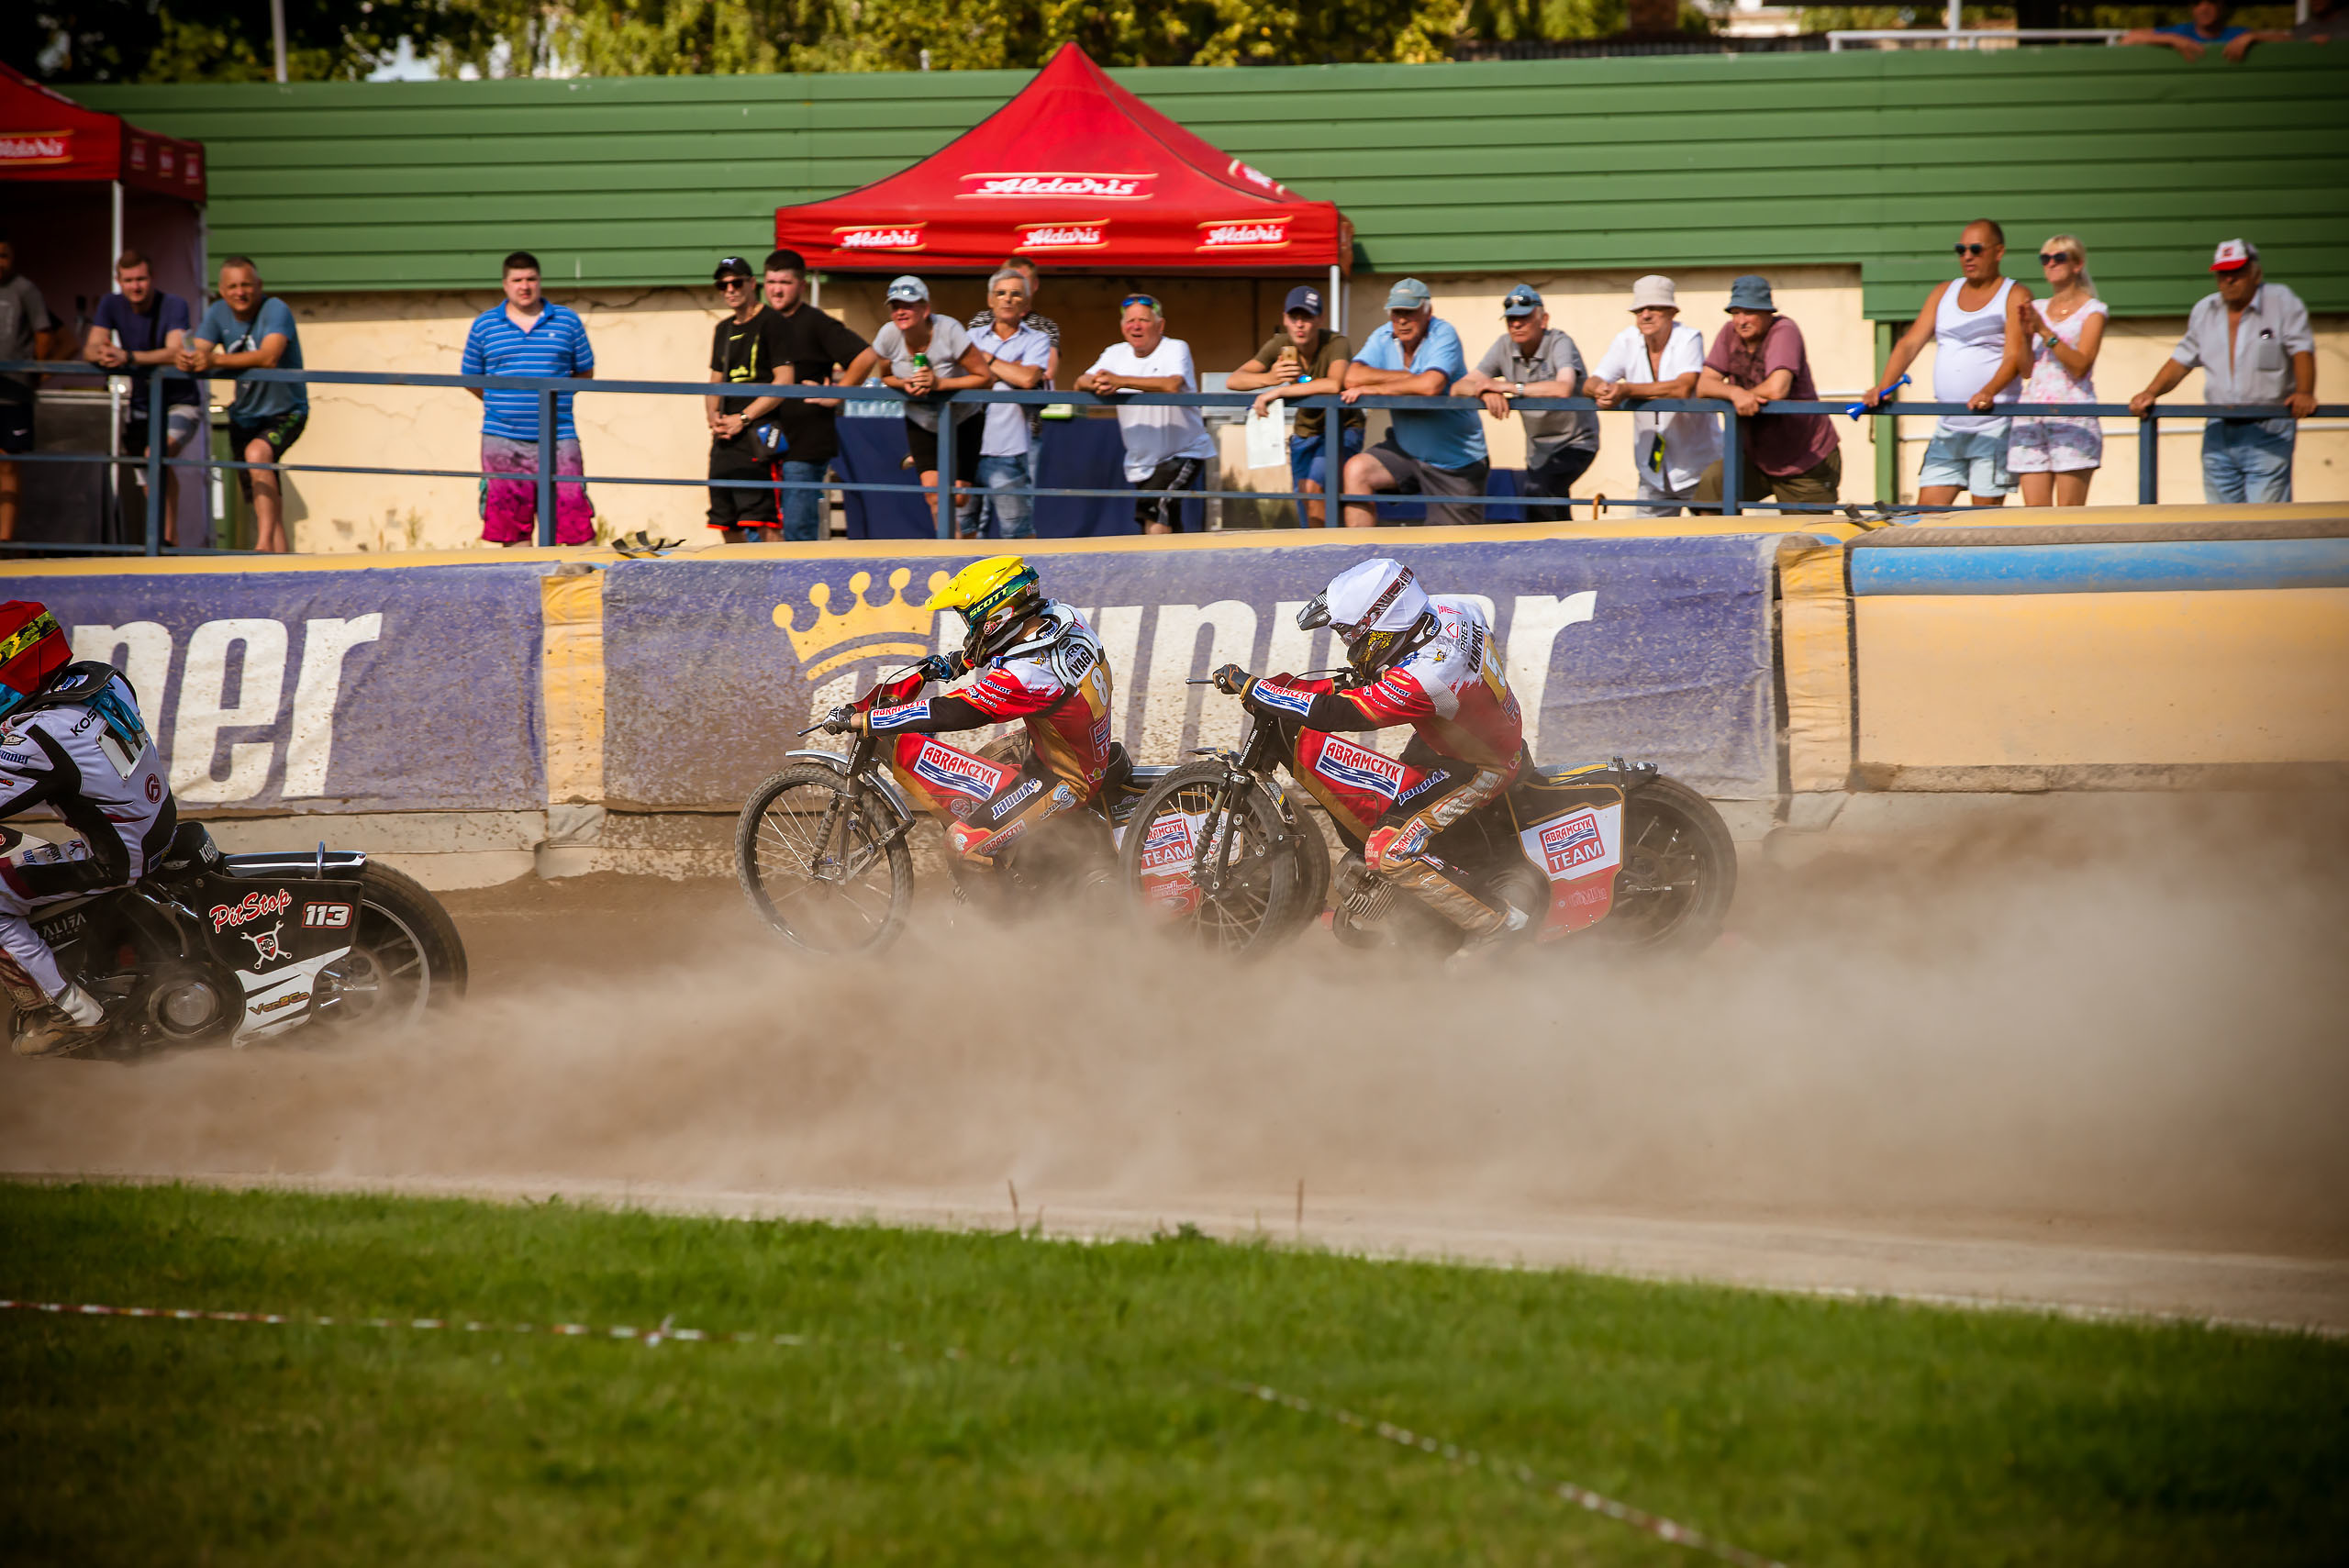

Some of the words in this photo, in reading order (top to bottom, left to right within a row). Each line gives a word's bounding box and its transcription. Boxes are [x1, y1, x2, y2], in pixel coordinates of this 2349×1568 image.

[976, 177, 1140, 195] Aldaris
[841, 229, 918, 249] Aldaris
[1022, 227, 1101, 247] Aldaris
[1205, 225, 1285, 245] Aldaris
[969, 585, 1009, 618] SCOTT
[1468, 619, 1484, 674] LAMPART
[1068, 648, 1094, 679] LYAG
[1486, 646, 1506, 688] 5
[1091, 666, 1108, 707] 8
[1259, 680, 1314, 703] ABRAMCZYK
[923, 746, 998, 786] ABRAMCZYK
[1326, 742, 1401, 782] ABRAMCZYK
[980, 822, 1025, 853] ABRAMCZYK
[1147, 823, 1184, 840] RAMCZYK
[1387, 820, 1424, 858] ABRAMCZYK
[1545, 819, 1593, 843] ABRAMCZYK
[1143, 843, 1193, 867] TEAM
[1550, 840, 1603, 870] TEAM
[209, 888, 292, 934] PitStop
[305, 905, 350, 926] 113
[260, 939, 275, 951] MTC
[248, 991, 311, 1016] Van2Go
